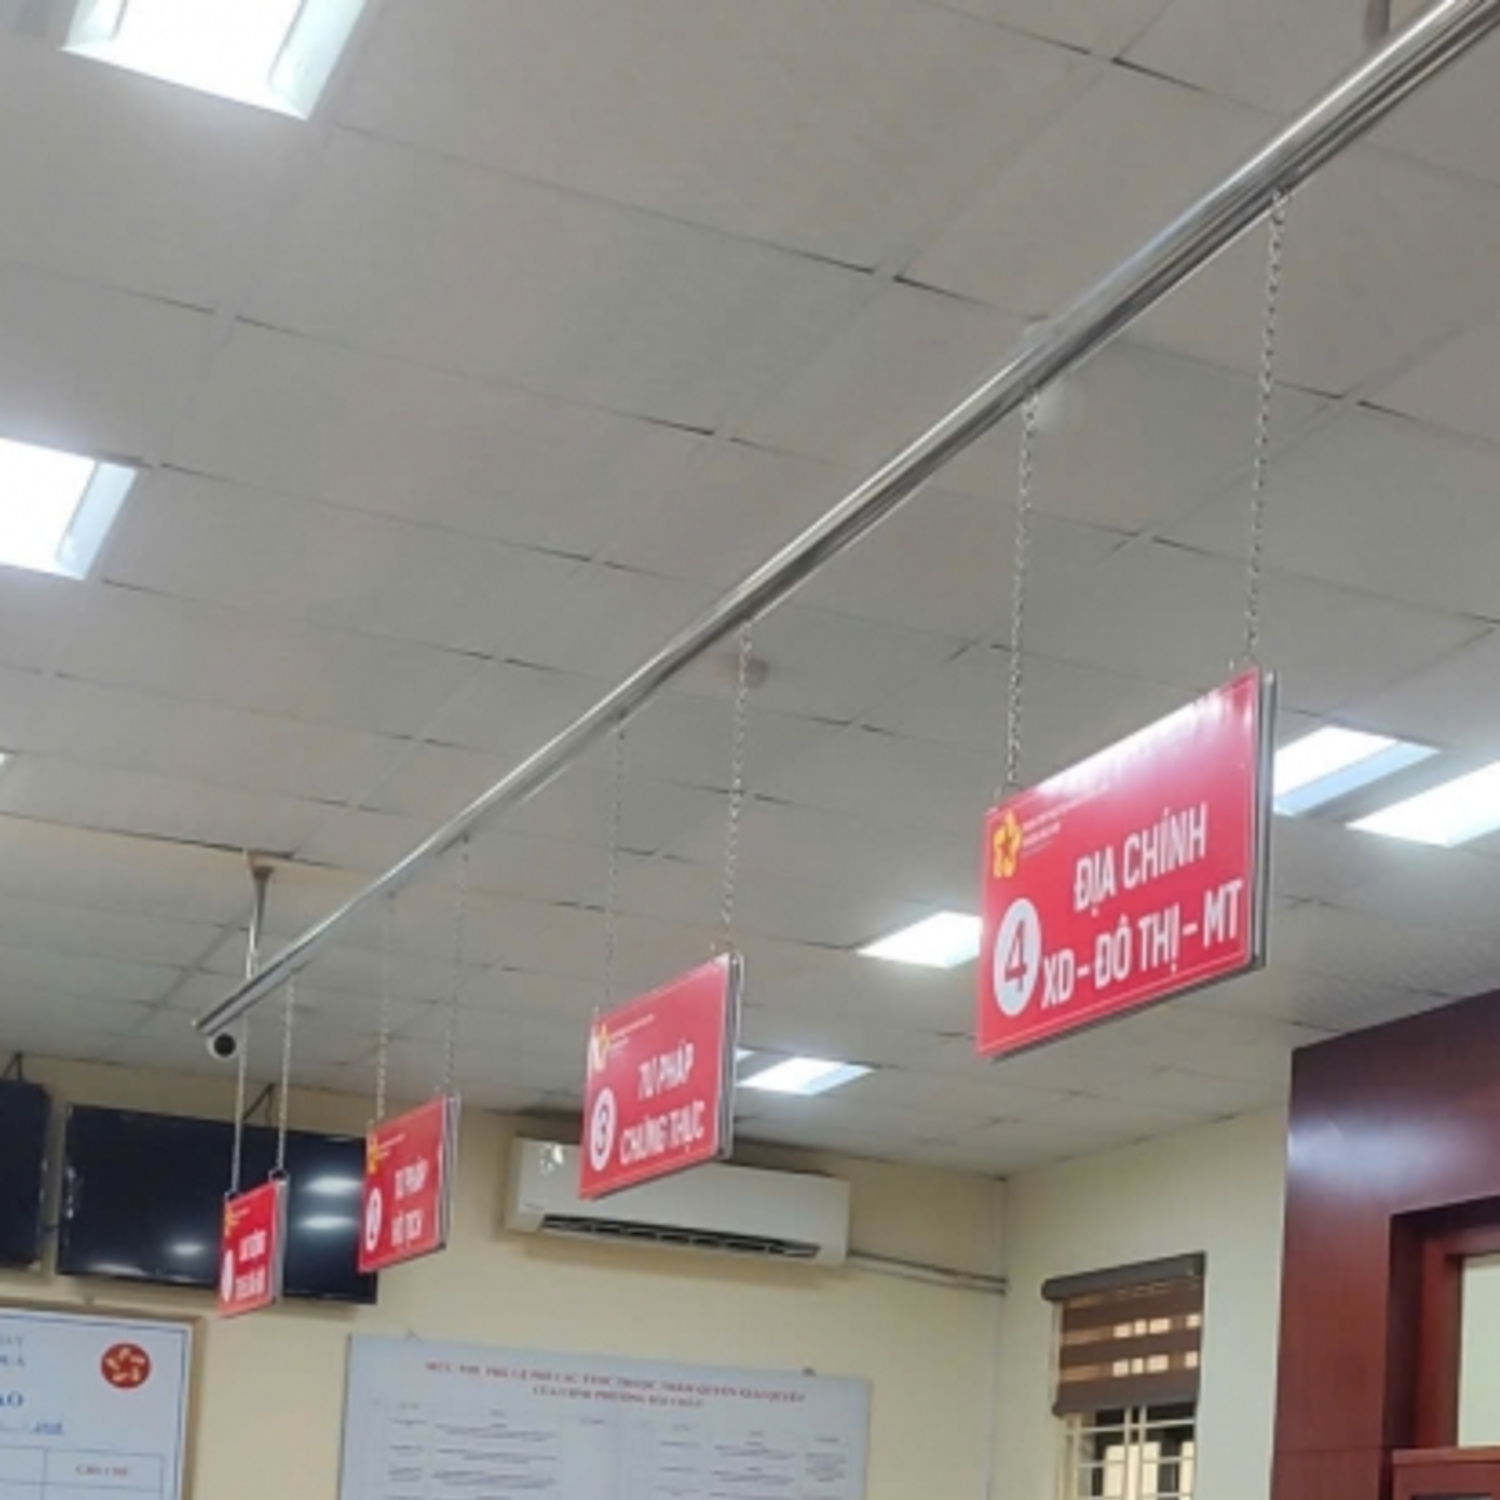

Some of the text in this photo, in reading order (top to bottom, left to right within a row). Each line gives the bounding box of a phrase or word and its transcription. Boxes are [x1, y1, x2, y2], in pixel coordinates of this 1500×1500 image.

[1073, 845, 1117, 918] ĐỊA
[1123, 802, 1208, 891] CHÍNH
[1004, 918, 1027, 994] 4
